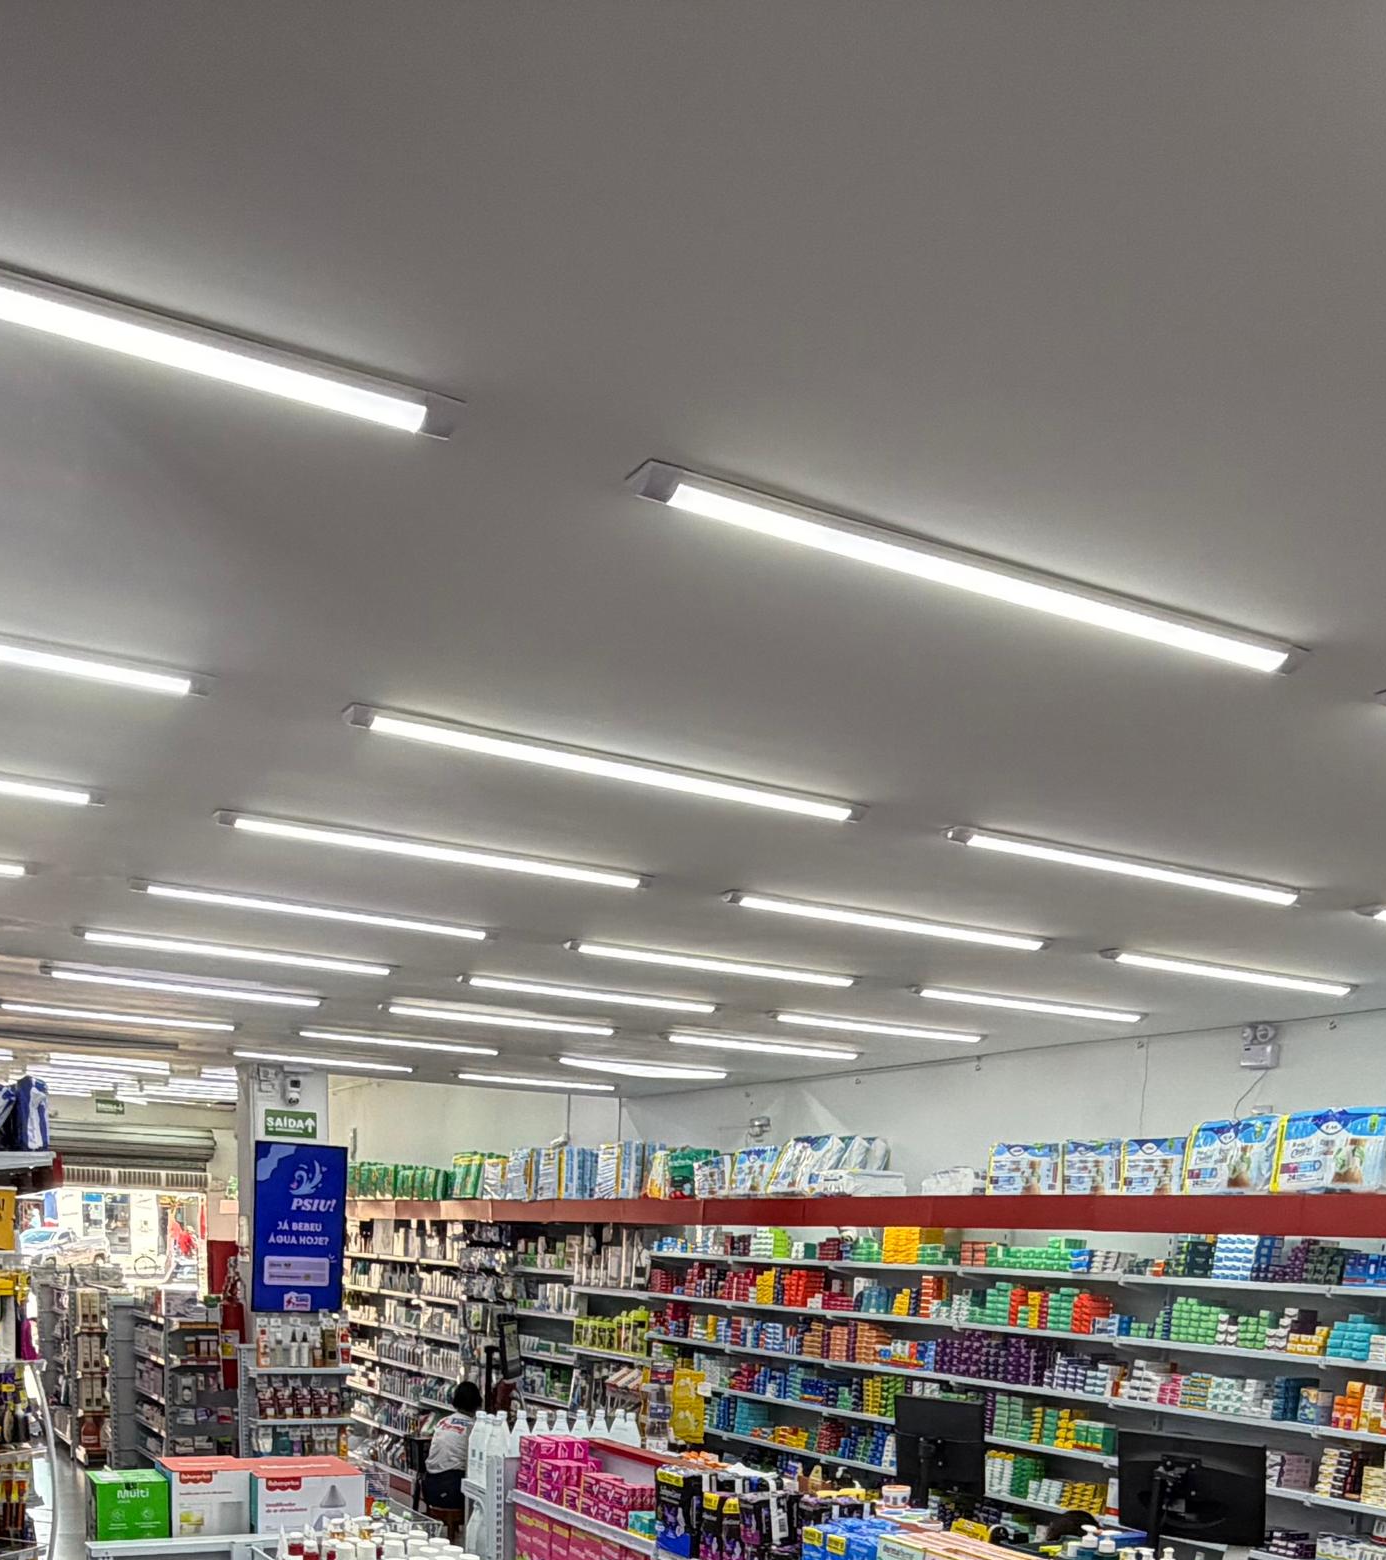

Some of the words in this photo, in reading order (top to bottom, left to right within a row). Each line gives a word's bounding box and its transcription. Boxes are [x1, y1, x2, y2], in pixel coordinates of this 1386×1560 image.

[266, 1116, 305, 1130] SAÍDA
[291, 1198, 337, 1212] PSIU!
[277, 1219, 290, 1231] JÁ
[292, 1221, 322, 1233] BEBEU
[268, 1233, 298, 1245] ÁGUA
[299, 1235, 330, 1246] HOJE?
[117, 1488, 150, 1499] Multi
